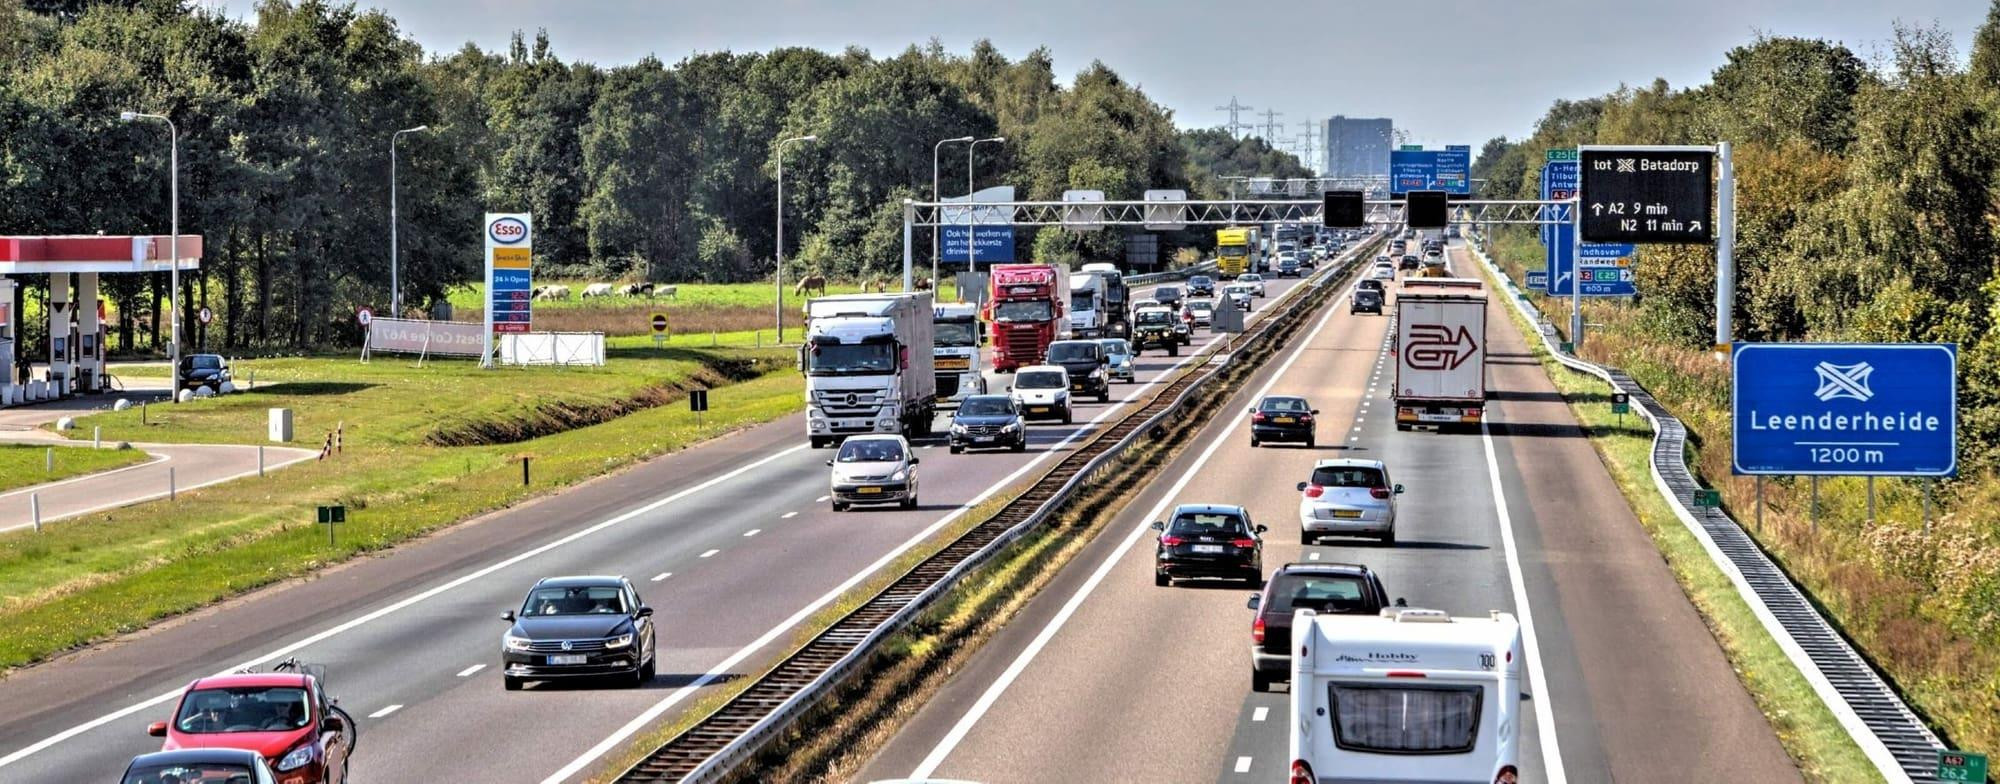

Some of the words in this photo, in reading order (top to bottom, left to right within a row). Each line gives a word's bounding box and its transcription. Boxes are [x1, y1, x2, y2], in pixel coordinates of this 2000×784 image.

[1593, 159, 1612, 170] tot
[1640, 158, 1699, 173] Batadorp
[1553, 191, 1567, 199] A2
[1608, 203, 1624, 214] A2
[1633, 202, 1641, 214] 9
[1646, 203, 1668, 214] min
[495, 223, 522, 235] Esso
[1621, 219, 1637, 231] N2
[1646, 219, 1657, 231] 11
[1661, 219, 1683, 231] min
[946, 229, 960, 237] Ook
[1751, 410, 1939, 431] Leenderheide
[1810, 448, 1859, 463] 1200
[1865, 450, 1884, 463] m
[1480, 654, 1496, 668] 100
